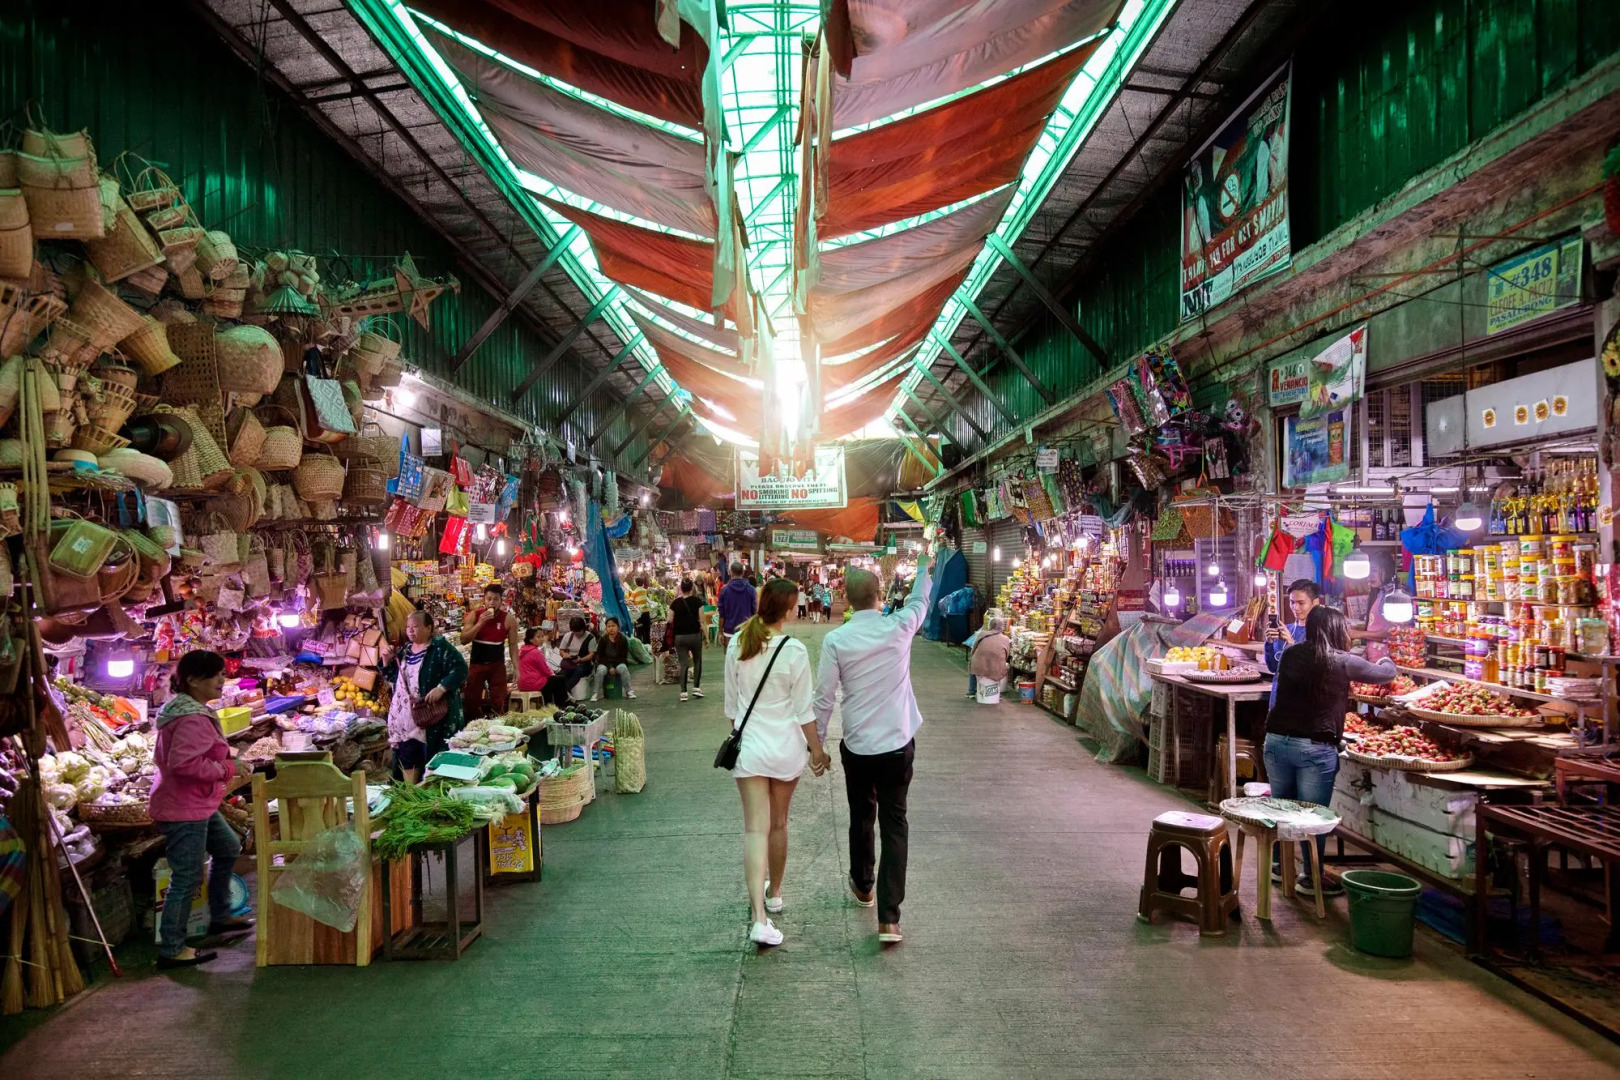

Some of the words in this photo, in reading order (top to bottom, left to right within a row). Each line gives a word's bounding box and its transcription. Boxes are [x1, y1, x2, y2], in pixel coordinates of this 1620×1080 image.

[1222, 235, 1235, 257] FOR
[1252, 191, 1285, 235] SMOKIN
[1510, 257, 1552, 289] #348
[1490, 296, 1552, 325] PASALUBONG
[1280, 376, 1308, 391] VENANCIO
[742, 490, 758, 500] NO
[791, 489, 808, 499] NO
